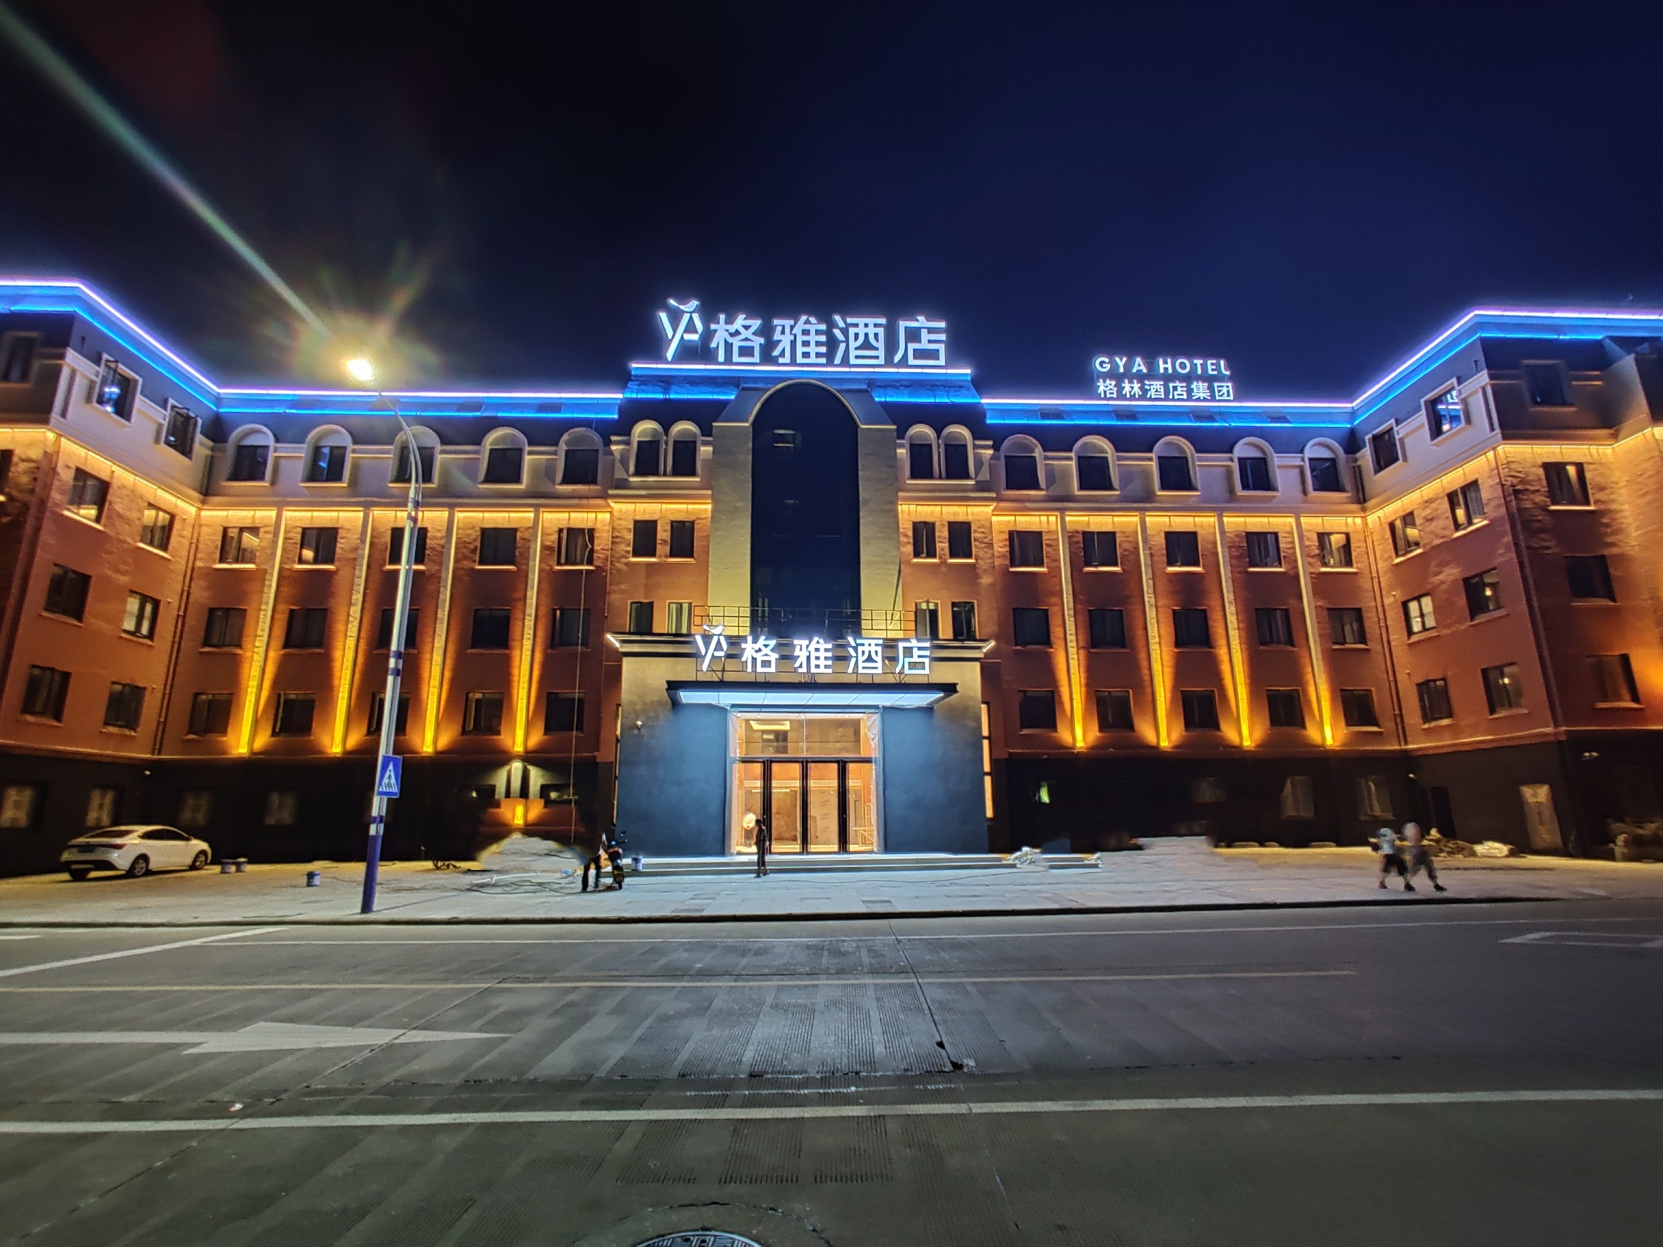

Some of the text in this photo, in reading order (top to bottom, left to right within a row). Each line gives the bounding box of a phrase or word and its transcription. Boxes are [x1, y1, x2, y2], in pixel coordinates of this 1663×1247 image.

[710, 313, 946, 366] 格雅酒店
[1095, 357, 1231, 375] GYA HOTEL
[1097, 379, 1234, 400] 格林酒店集团
[741, 635, 931, 674] 格雅酒店
